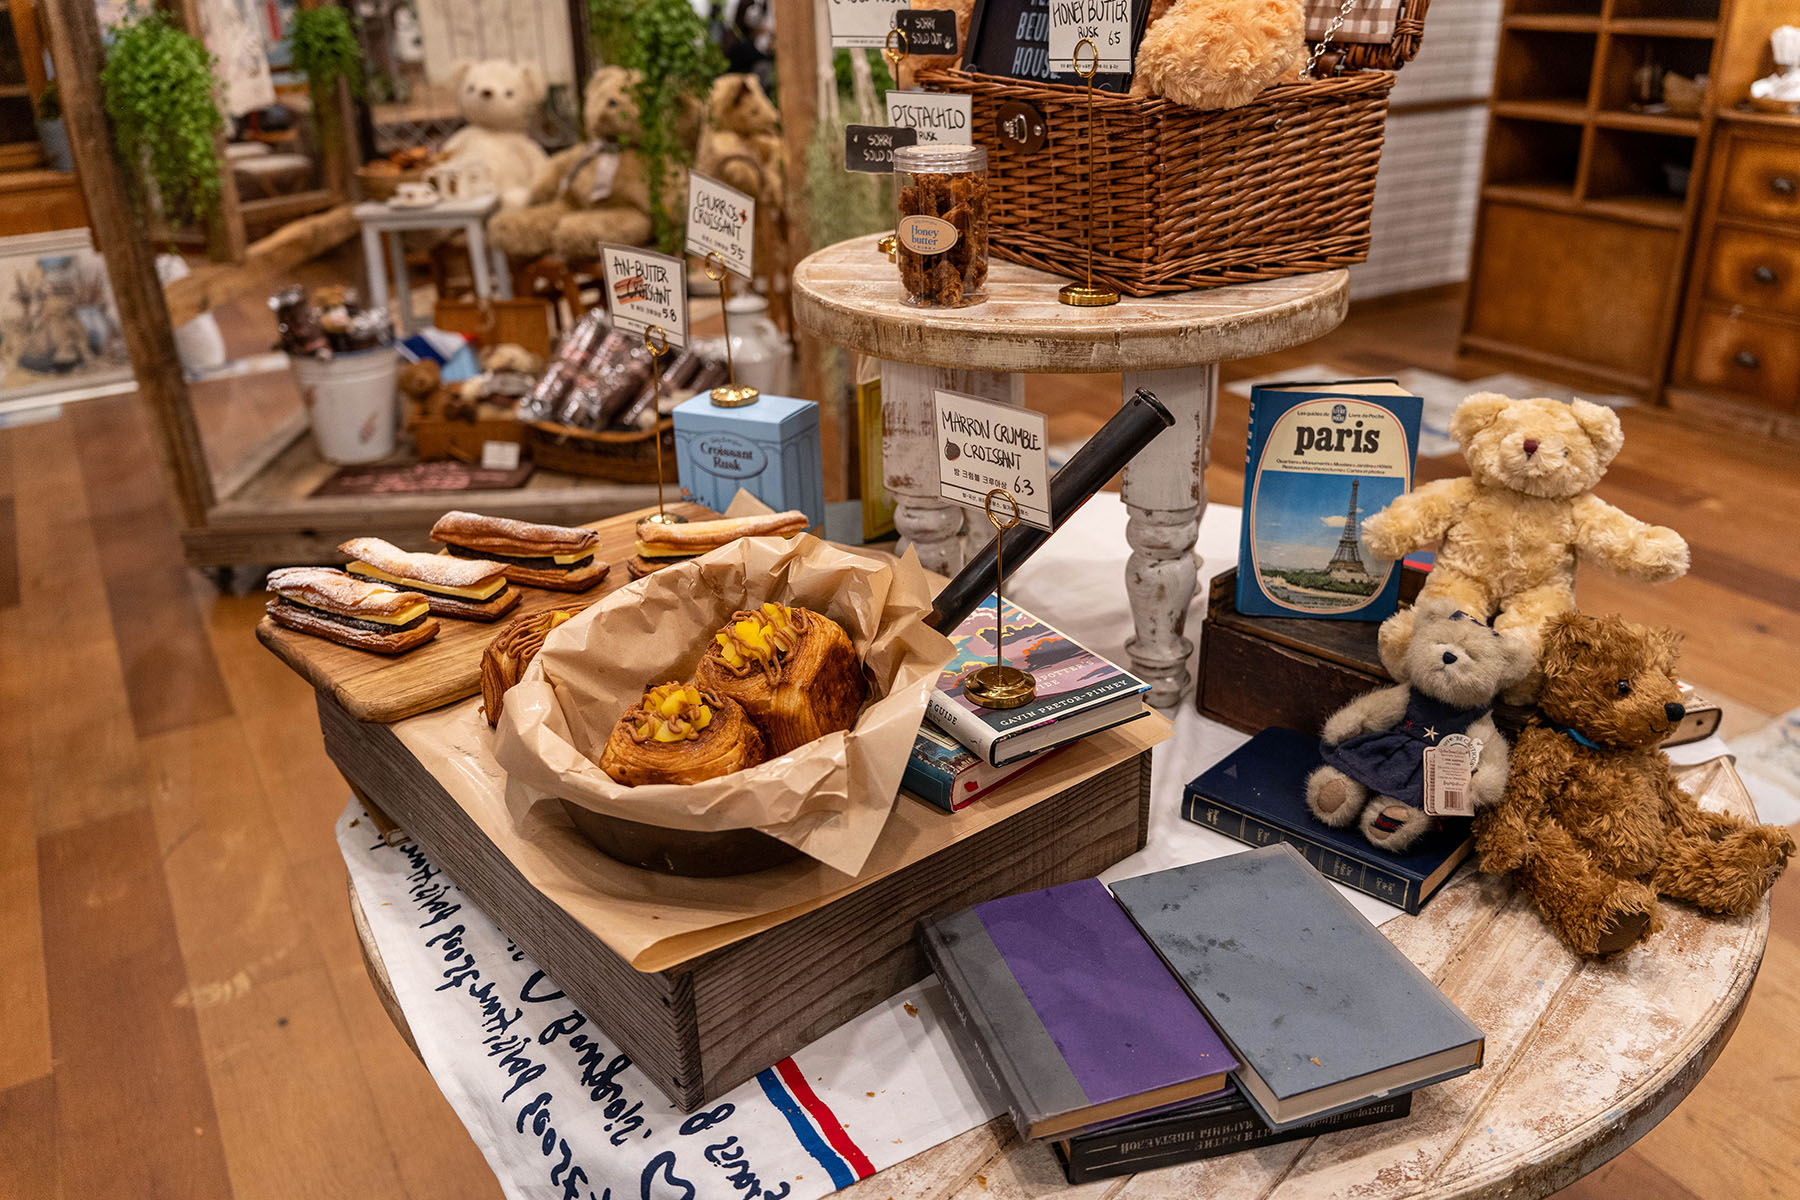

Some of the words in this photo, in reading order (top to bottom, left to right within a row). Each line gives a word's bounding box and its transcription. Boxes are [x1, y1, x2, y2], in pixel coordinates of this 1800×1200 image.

[1052, 2, 1085, 28] HONEY
[1088, 0, 1128, 23] BUTTER
[1078, 26, 1099, 39] RUSK
[891, 104, 966, 130] PISTACHIO
[866, 133, 894, 147] SORRY
[918, 130, 938, 142] RUSK
[863, 149, 885, 162] SOLD
[696, 190, 739, 223] CHURROS
[911, 224, 938, 239] Honey
[911, 236, 938, 246] butter
[613, 255, 669, 284] AN-BUTTER
[941, 407, 990, 440] MARRON
[993, 423, 1042, 451] CRUMBLE
[1294, 420, 1380, 456] paris
[700, 441, 753, 460] Croissant
[713, 456, 742, 472] Rusk
[1013, 475, 1035, 496] 6.3
[1000, 710, 1036, 727] GAVIN
[1037, 679, 1128, 714] PRETOR-PINNEY
[935, 703, 958, 726] GUIDE
